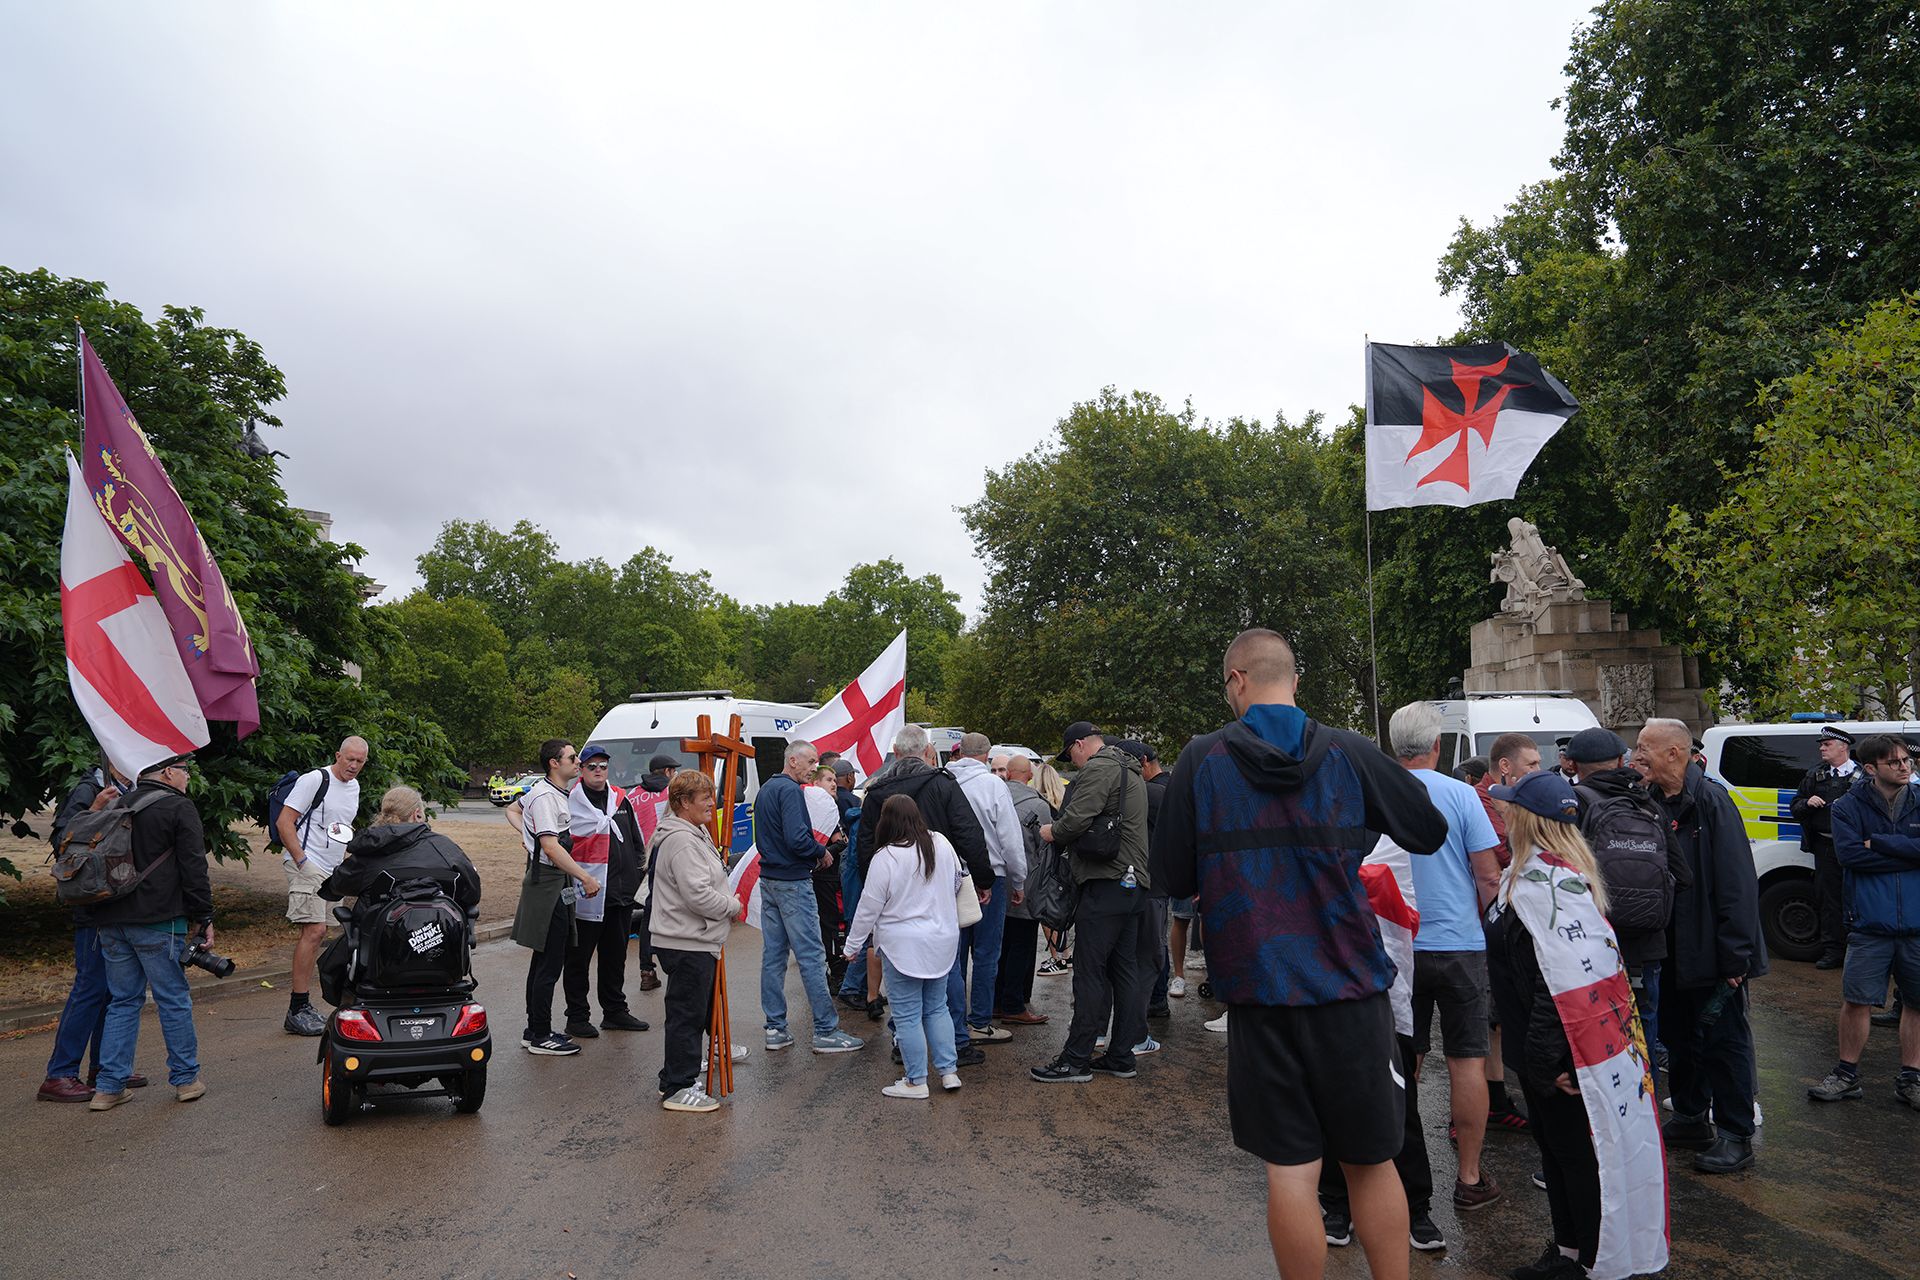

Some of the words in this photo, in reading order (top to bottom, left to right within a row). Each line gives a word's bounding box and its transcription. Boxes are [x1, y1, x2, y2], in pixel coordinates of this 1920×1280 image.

[775, 719, 800, 731] POL
[408, 923, 442, 947] DRUNK!
[417, 938, 443, 954] POTHOLES
